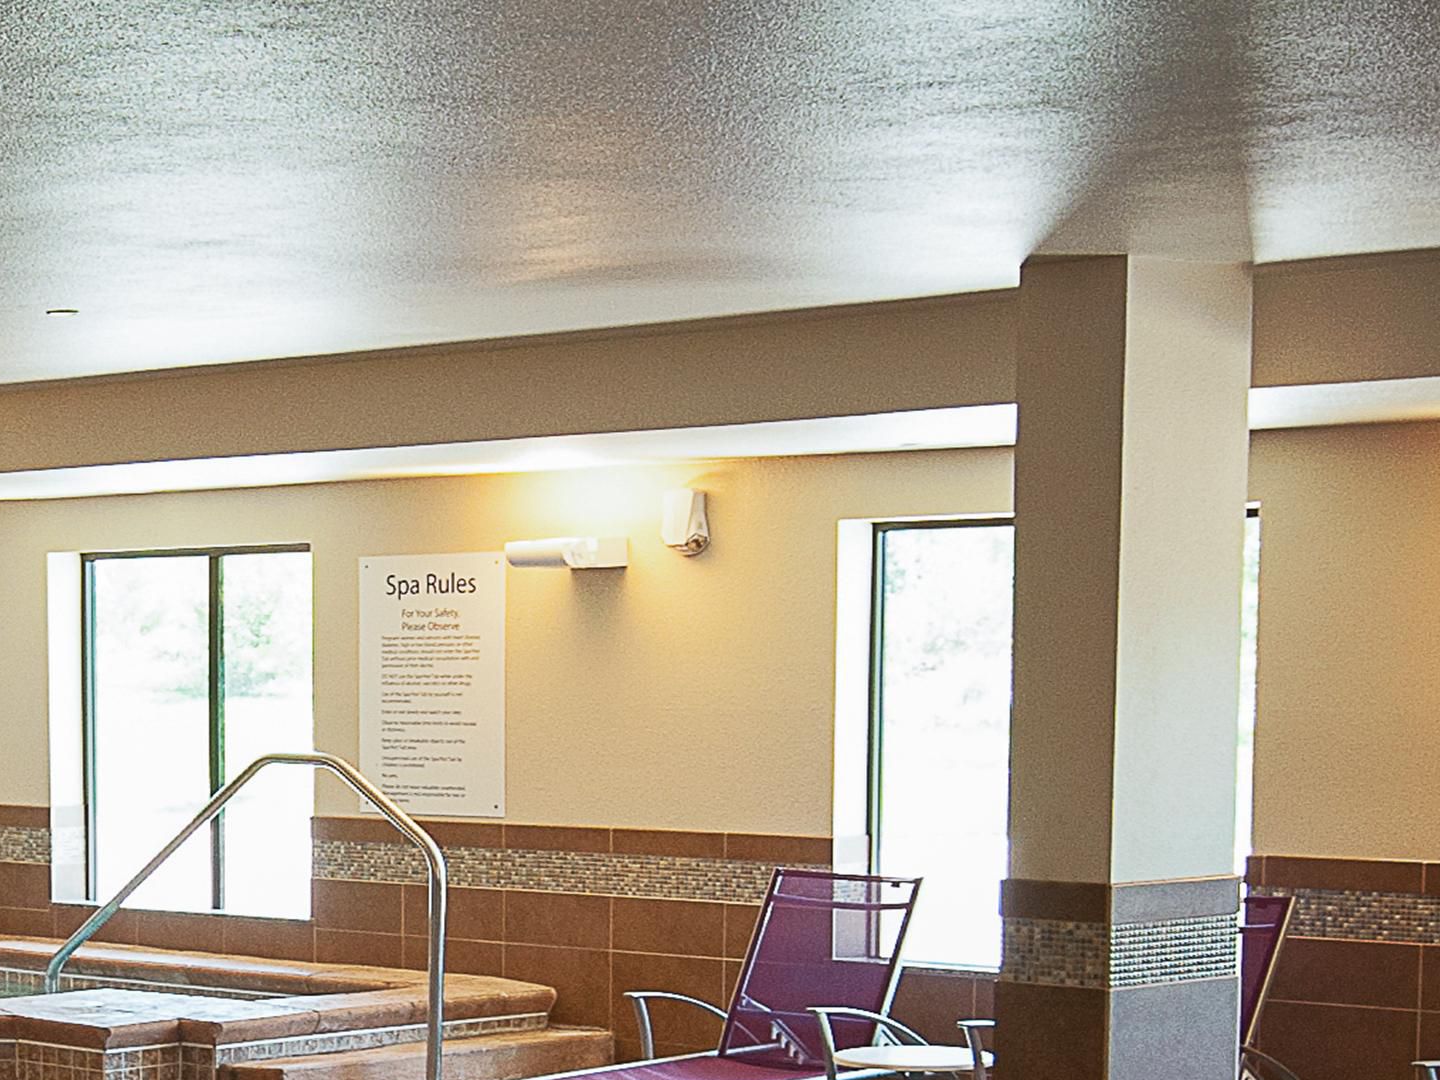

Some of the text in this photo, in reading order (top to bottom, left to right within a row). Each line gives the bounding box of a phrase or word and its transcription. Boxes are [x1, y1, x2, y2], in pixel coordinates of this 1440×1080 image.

[386, 572, 477, 600] Spa Rules
[401, 608, 414, 618] For
[416, 608, 433, 618] Your
[401, 621, 460, 631] Please Observe
